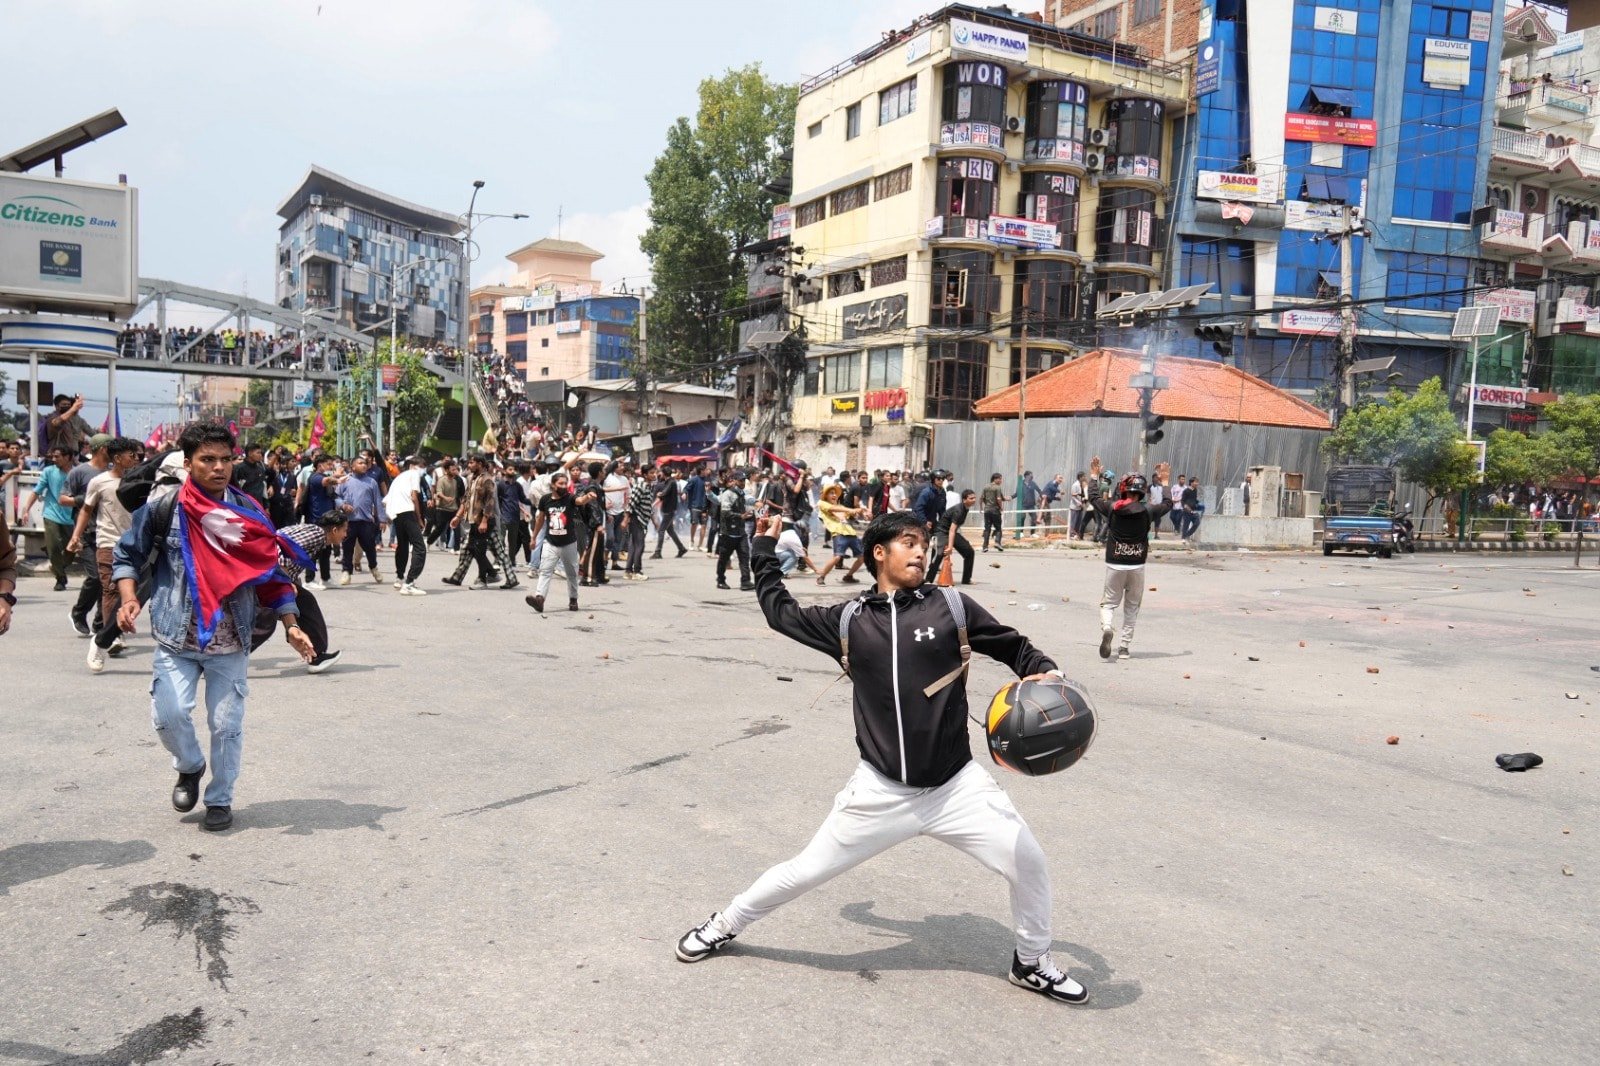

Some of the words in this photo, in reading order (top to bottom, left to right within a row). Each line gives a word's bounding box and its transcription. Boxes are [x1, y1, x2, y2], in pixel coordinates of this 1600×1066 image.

[971, 31, 999, 45] HAPPY
[1000, 37, 1026, 51] PANDA
[1434, 40, 1469, 50] EDUVICE
[954, 132, 971, 143] USA
[972, 133, 987, 144] PTE
[1134, 167, 1147, 175] AUS
[1219, 174, 1259, 186] PASSION
[1, 203, 86, 227] Citizens
[89, 217, 118, 229] Bank
[1499, 218, 1523, 226] JAPAN
[55, 243, 80, 251] BANKER
[864, 388, 906, 411] AMIGO
[1480, 388, 1523, 404] GORETO
